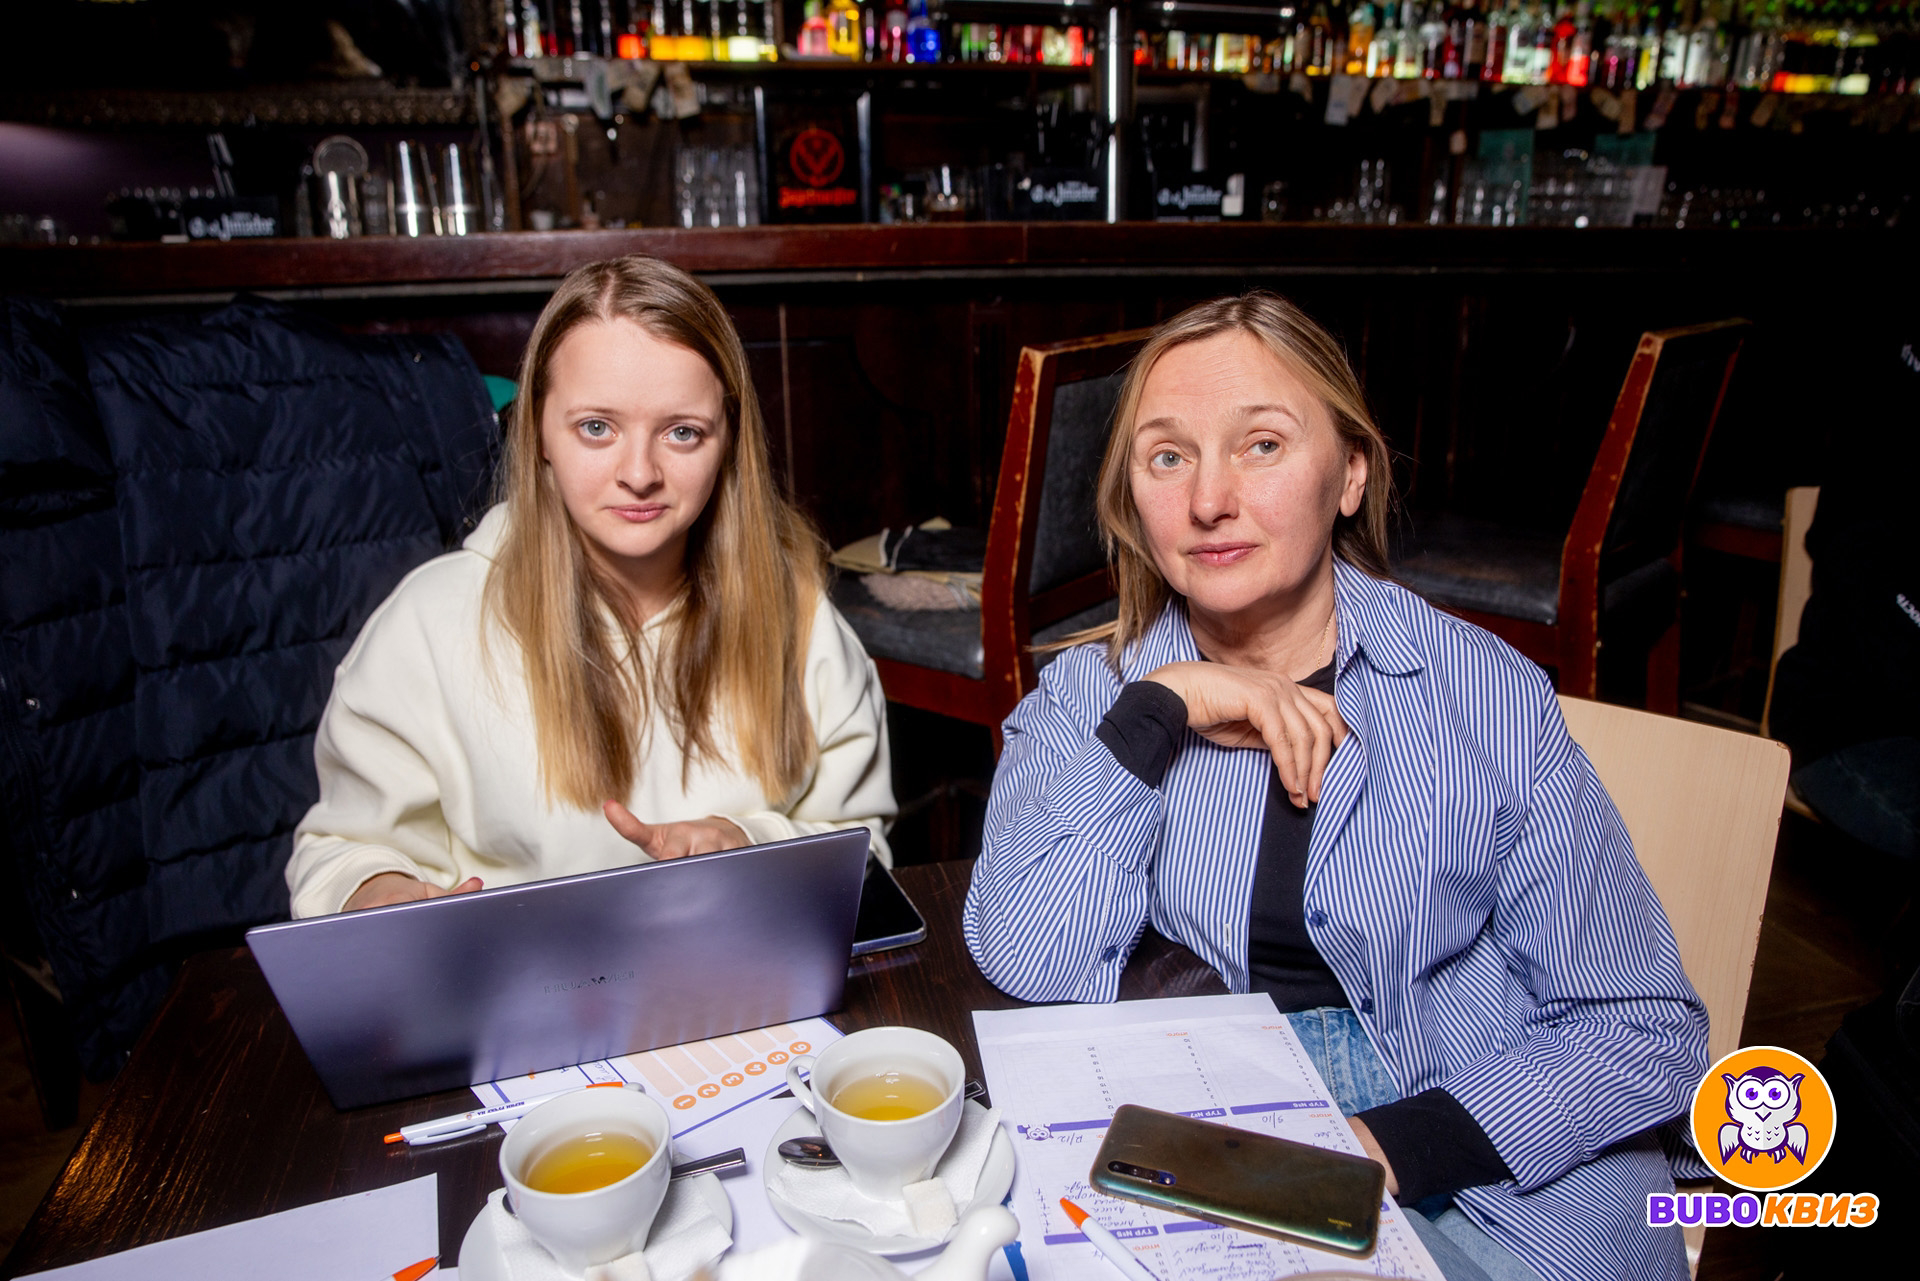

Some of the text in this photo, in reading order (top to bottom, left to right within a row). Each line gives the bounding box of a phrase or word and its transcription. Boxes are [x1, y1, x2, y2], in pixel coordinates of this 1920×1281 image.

[794, 1044, 808, 1052] 6
[772, 1054, 786, 1062] 5
[750, 1064, 762, 1072] 4
[726, 1075, 740, 1085] 3
[702, 1086, 717, 1096] 2
[678, 1098, 691, 1107] 1
[1135, 1227, 1153, 1235] ТУР
